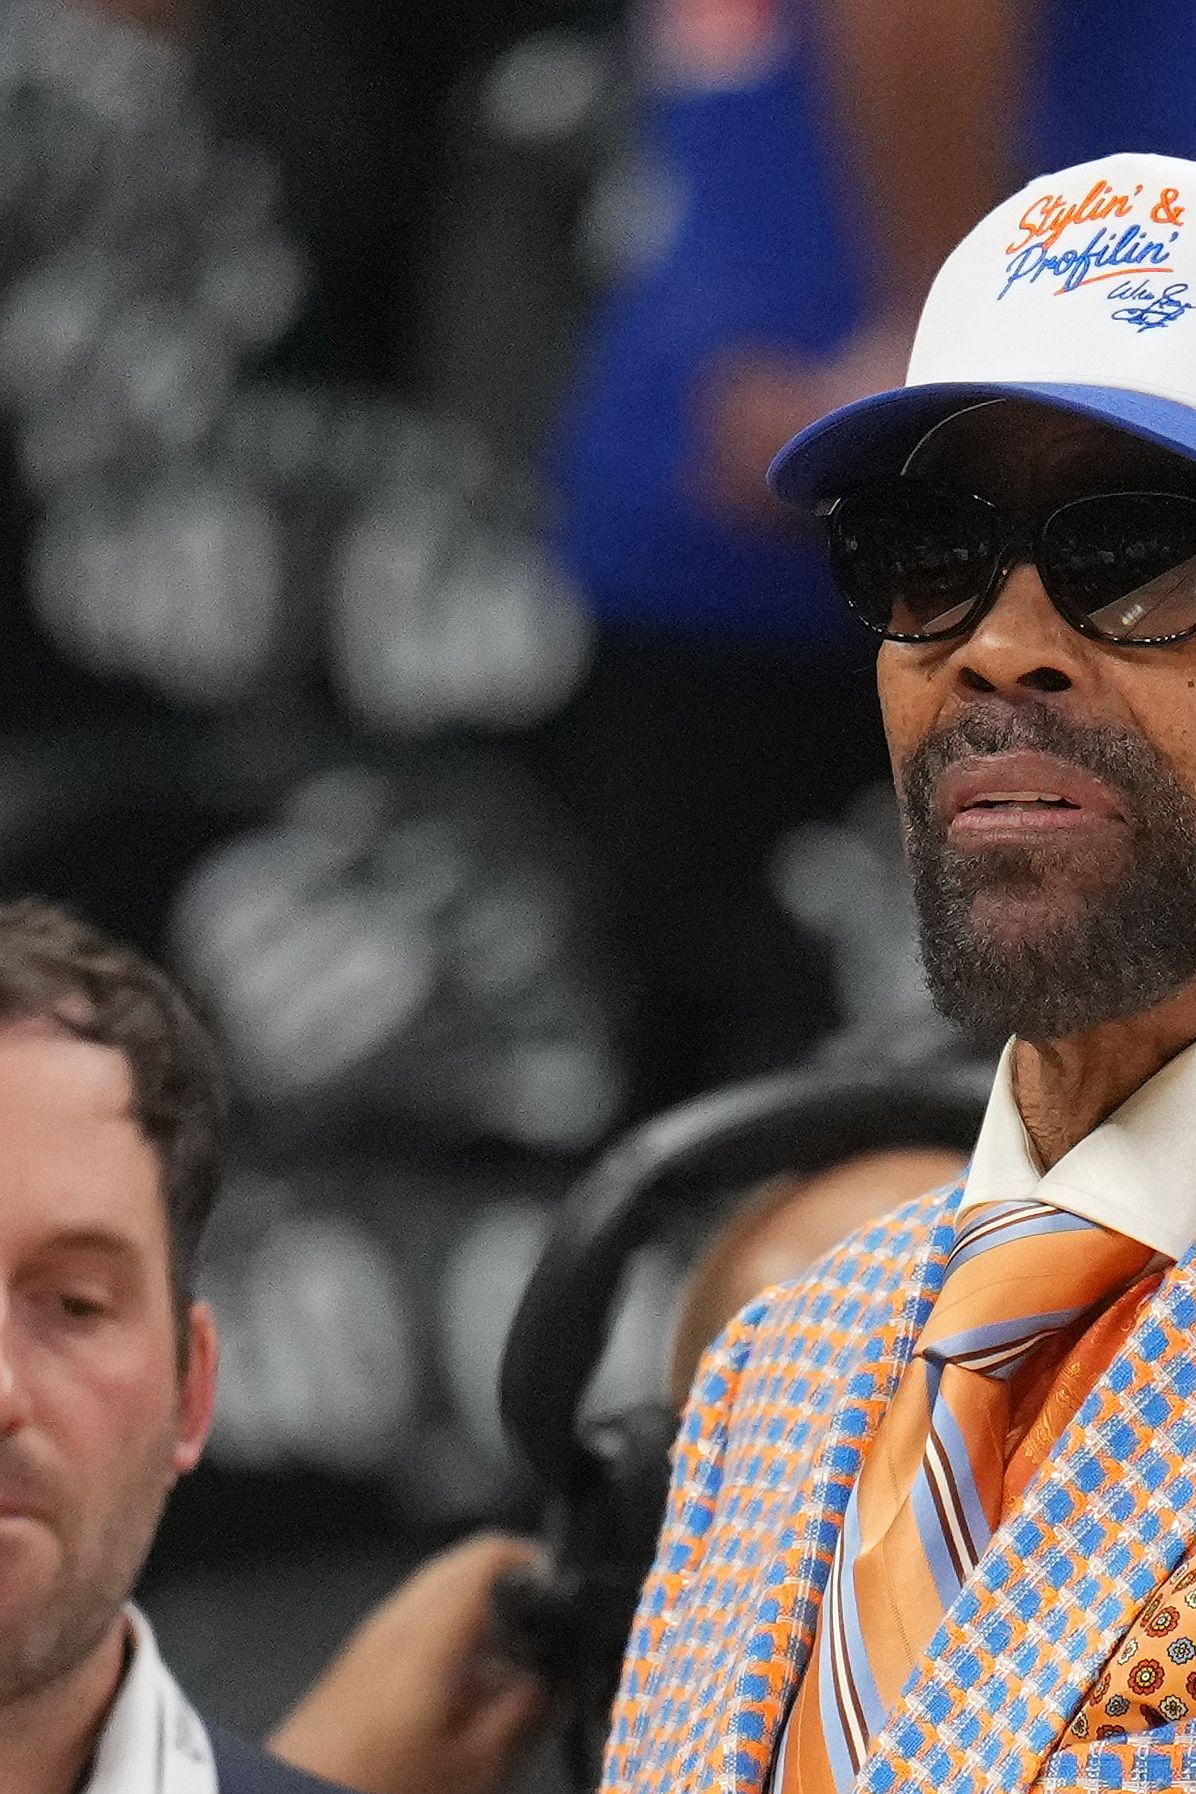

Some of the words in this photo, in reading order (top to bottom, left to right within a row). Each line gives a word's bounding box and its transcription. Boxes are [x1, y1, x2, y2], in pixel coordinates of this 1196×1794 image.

[1005, 179, 1144, 255] Stylin'
[1150, 187, 1185, 227] &
[996, 224, 1179, 301] Profilin'
